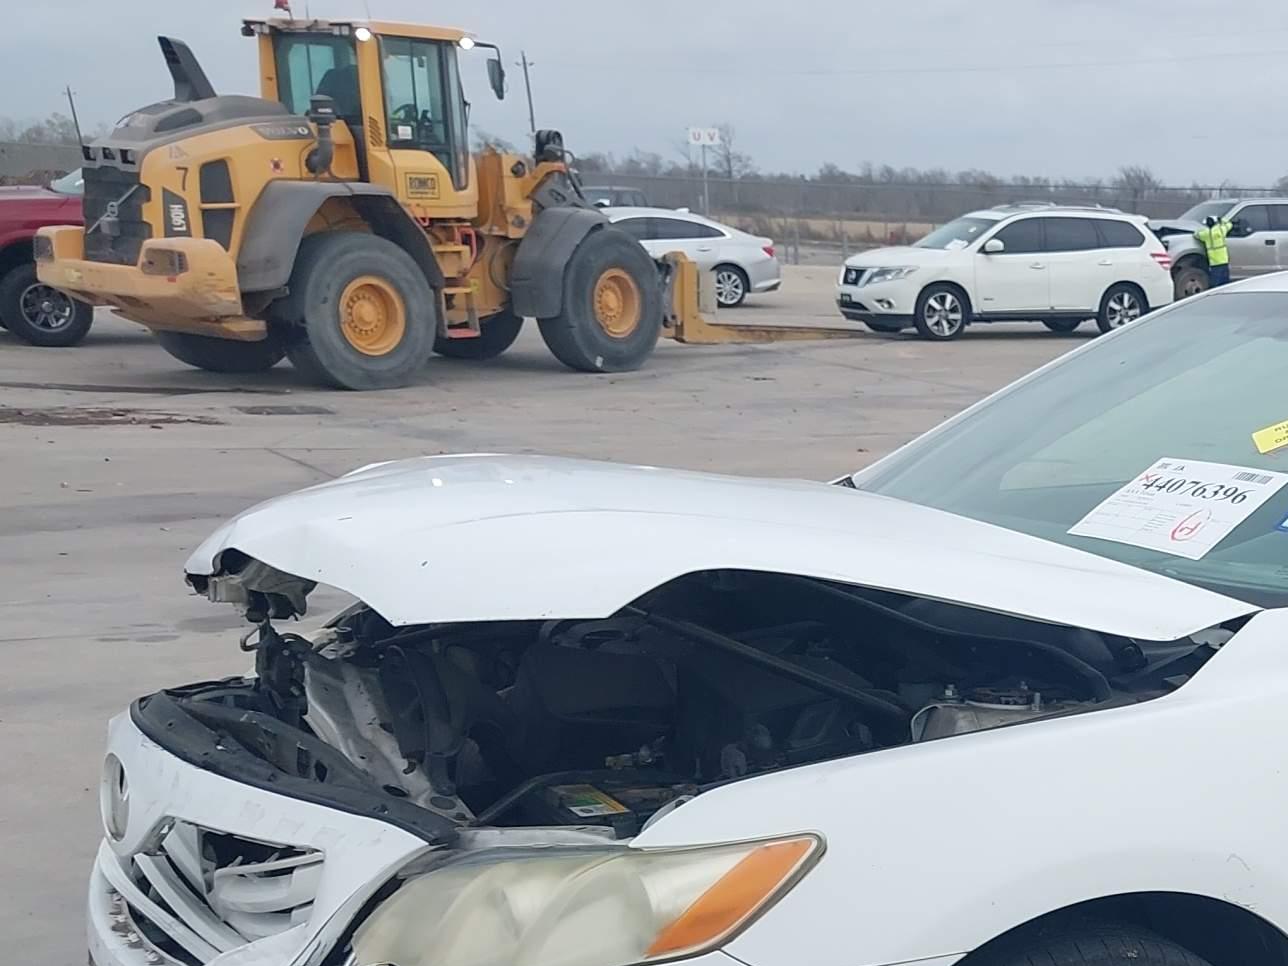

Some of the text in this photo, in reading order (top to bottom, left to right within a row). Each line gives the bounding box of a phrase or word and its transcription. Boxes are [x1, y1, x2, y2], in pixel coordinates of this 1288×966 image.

[176, 167, 188, 192] 7
[168, 204, 187, 231] L90H
[1142, 476, 1257, 505] 44076396
